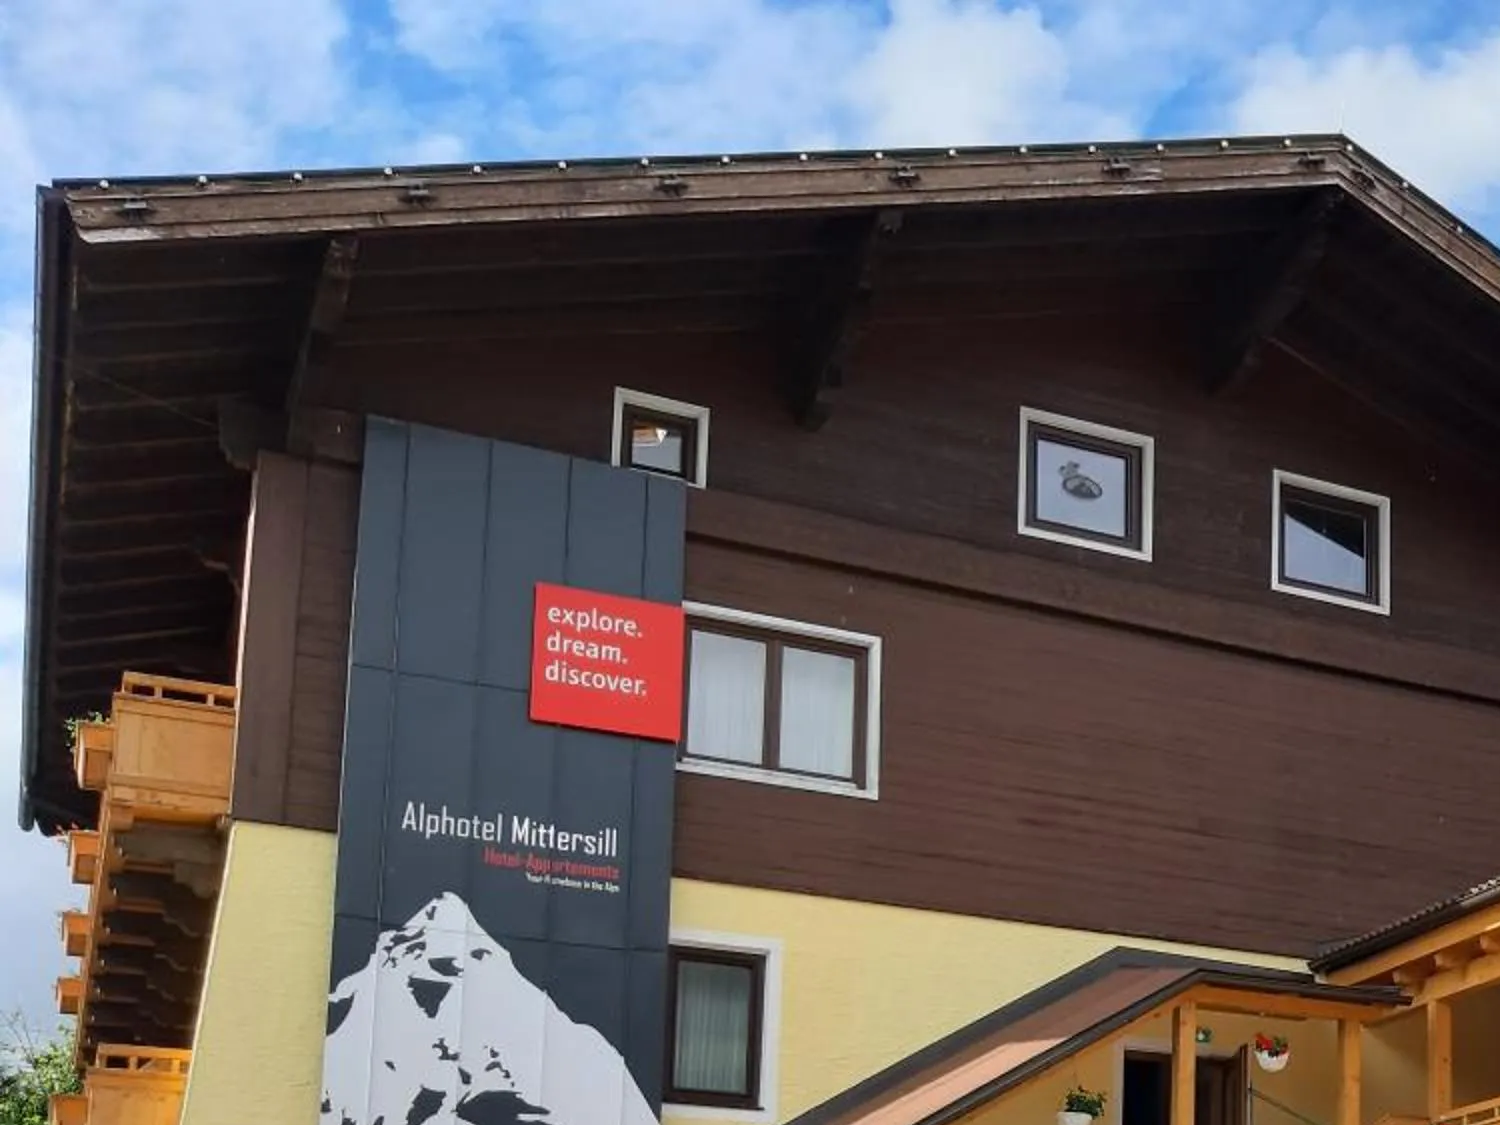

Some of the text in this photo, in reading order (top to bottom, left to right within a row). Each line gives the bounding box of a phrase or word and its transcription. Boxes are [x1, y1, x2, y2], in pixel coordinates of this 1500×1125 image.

[547, 606, 643, 638] explore.
[546, 630, 628, 664] dream.
[545, 659, 647, 696] discover.
[401, 801, 617, 857] Alphotel Mittersill
